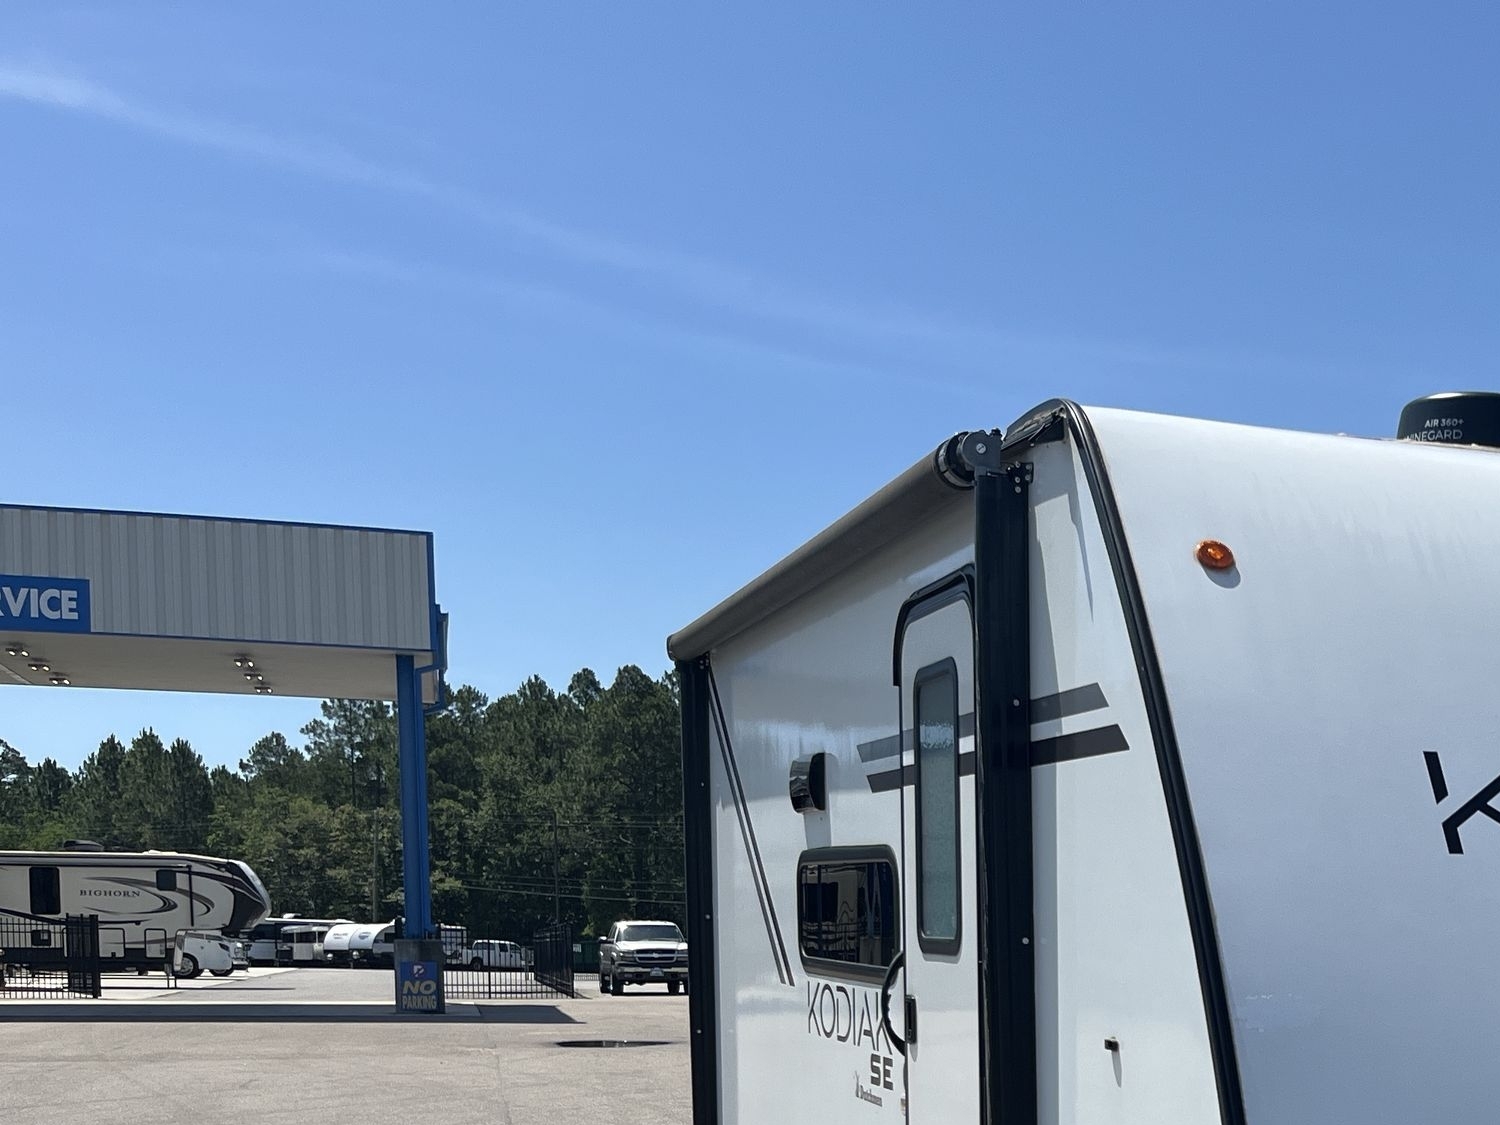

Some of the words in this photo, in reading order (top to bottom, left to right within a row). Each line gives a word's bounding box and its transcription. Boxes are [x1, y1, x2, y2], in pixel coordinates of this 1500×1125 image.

[1424, 419, 1439, 428] AIR
[79, 889, 140, 898] BIGHORN
[402, 980, 437, 995] NO
[402, 995, 437, 1009] PARKING
[807, 980, 893, 1055] KODIAK
[870, 1053, 894, 1091] SE
